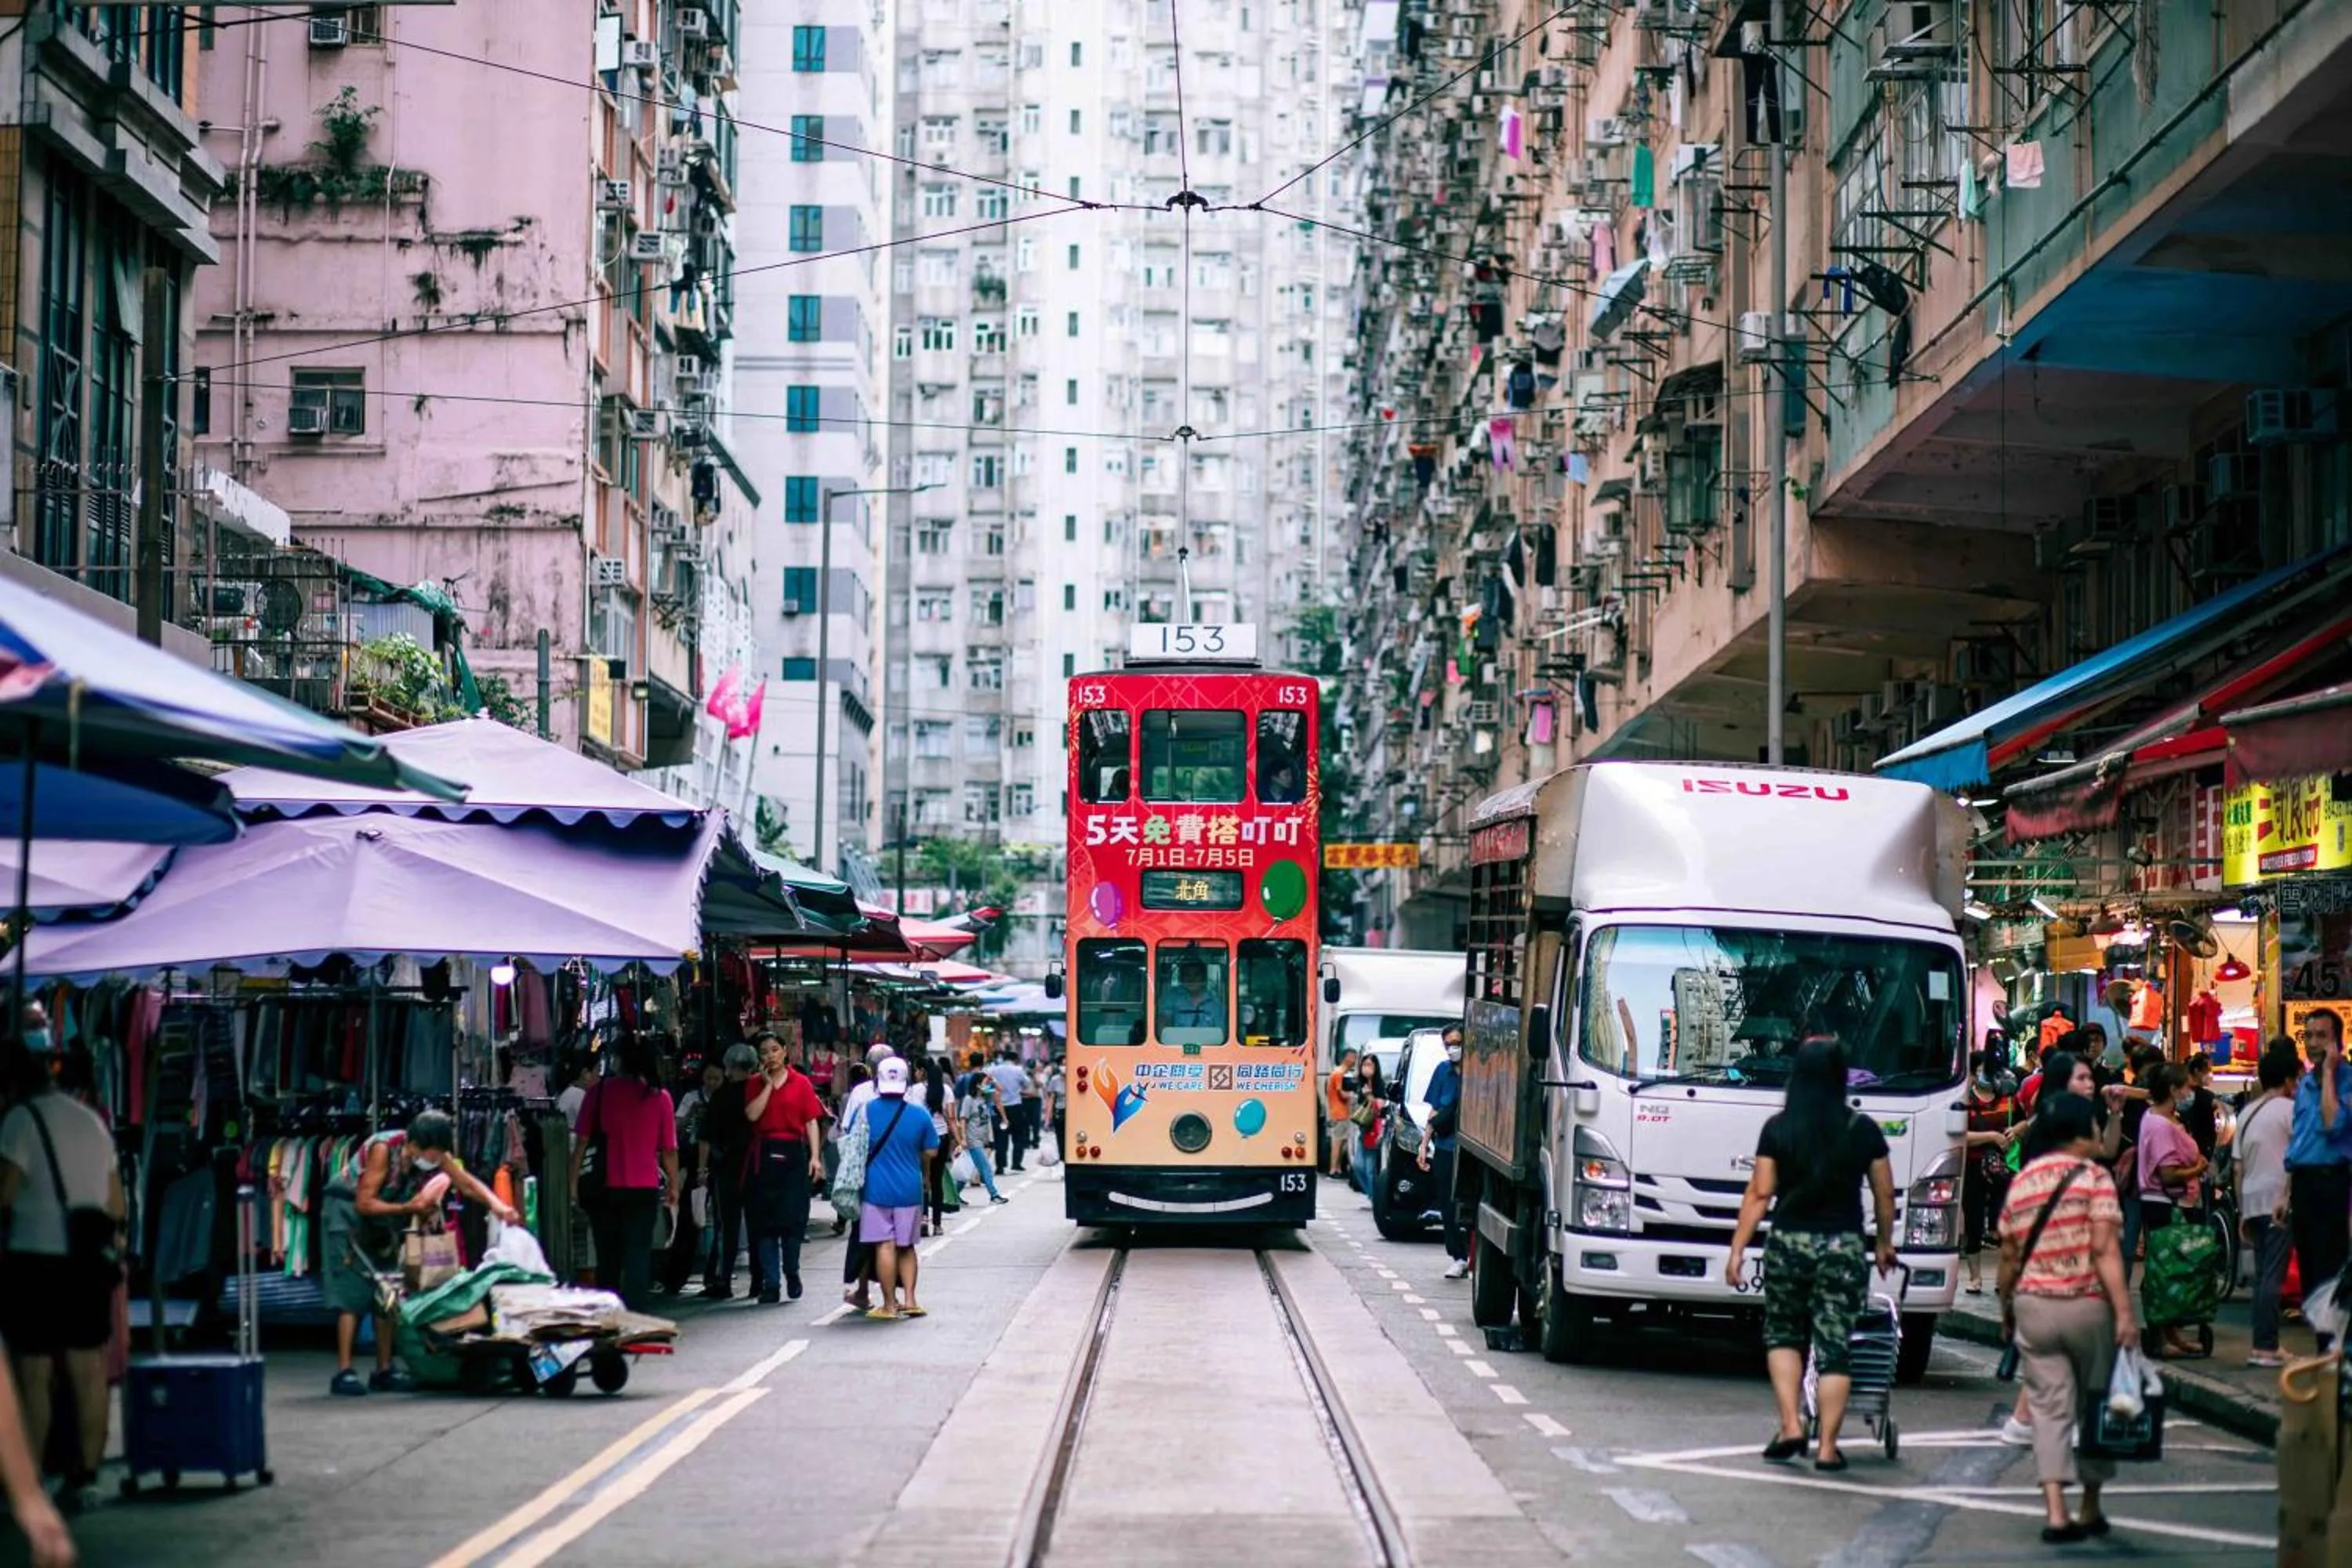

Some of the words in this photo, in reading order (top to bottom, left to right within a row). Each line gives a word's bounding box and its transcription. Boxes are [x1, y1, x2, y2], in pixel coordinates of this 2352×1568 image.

[1162, 626, 1225, 653] 153
[1077, 686, 1106, 703] 153
[1278, 686, 1308, 705] 153
[1682, 779, 1849, 801] ISUZU
[1086, 814, 1303, 846] 5天免費搭叮叮
[1125, 848, 1254, 867] 7月1日-7月5日
[1175, 880, 1210, 901] 北角
[2292, 960, 2341, 998] 45
[1159, 1080, 1174, 1090] WE
[1176, 1080, 1204, 1090] CARE
[1236, 1080, 1252, 1090] WE
[1254, 1080, 1297, 1090] CHERISH
[1280, 1174, 1308, 1192] 153
